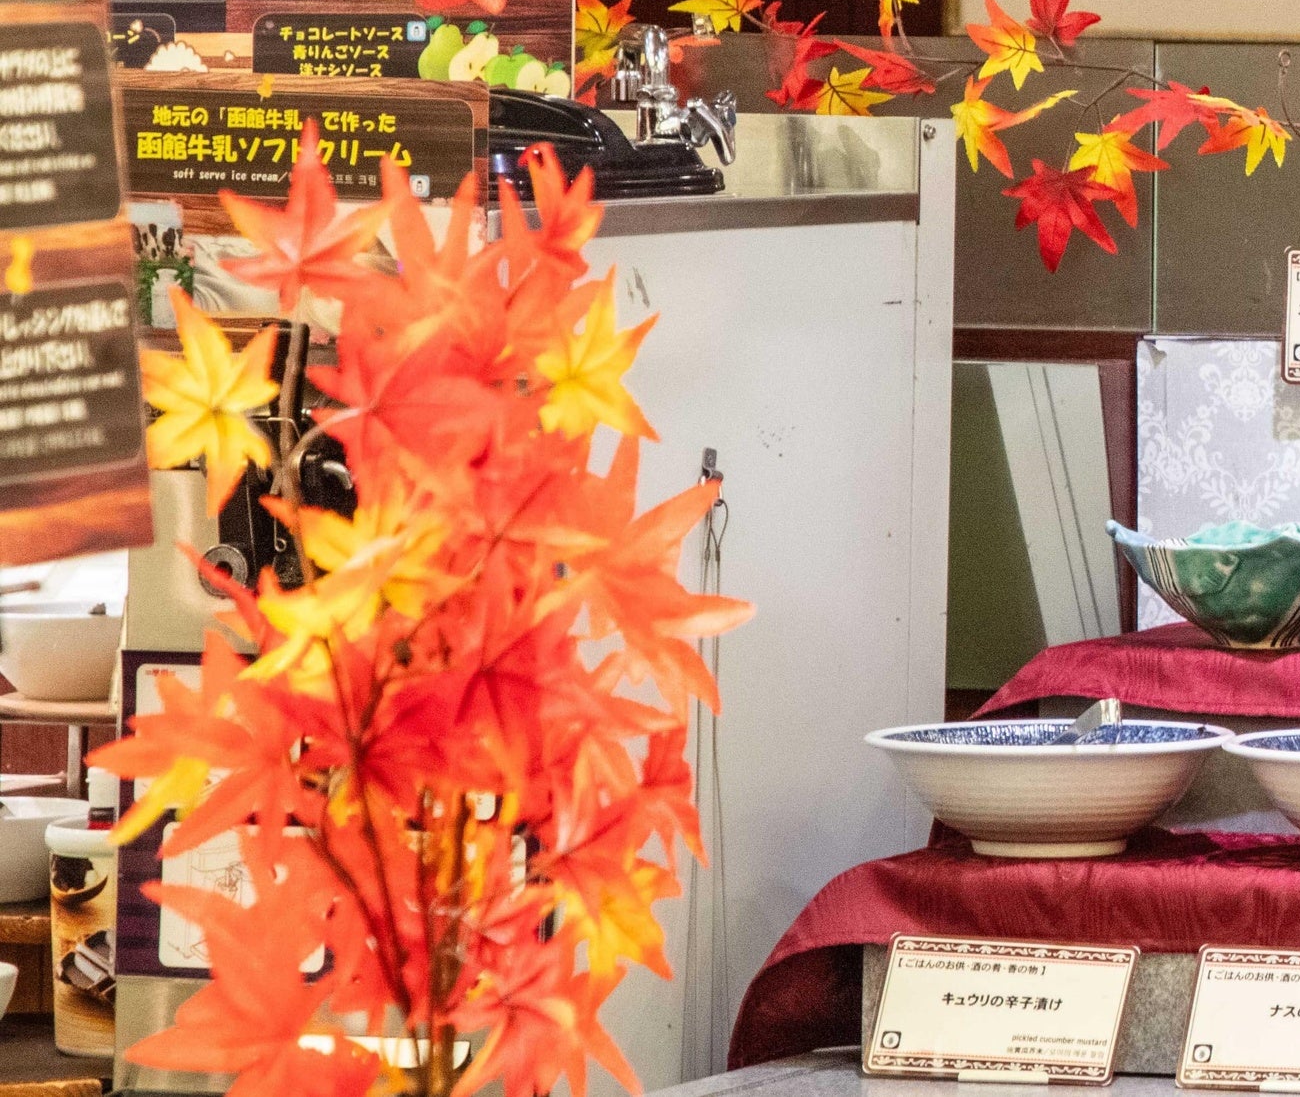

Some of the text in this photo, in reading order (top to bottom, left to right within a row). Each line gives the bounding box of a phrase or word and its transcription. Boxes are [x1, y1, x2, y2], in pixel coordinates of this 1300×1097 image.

[280, 26, 403, 41] チョコレートソース
[293, 45, 390, 60] 青りんごソース
[942, 992, 1063, 1011] キュウリの辛子漬け
